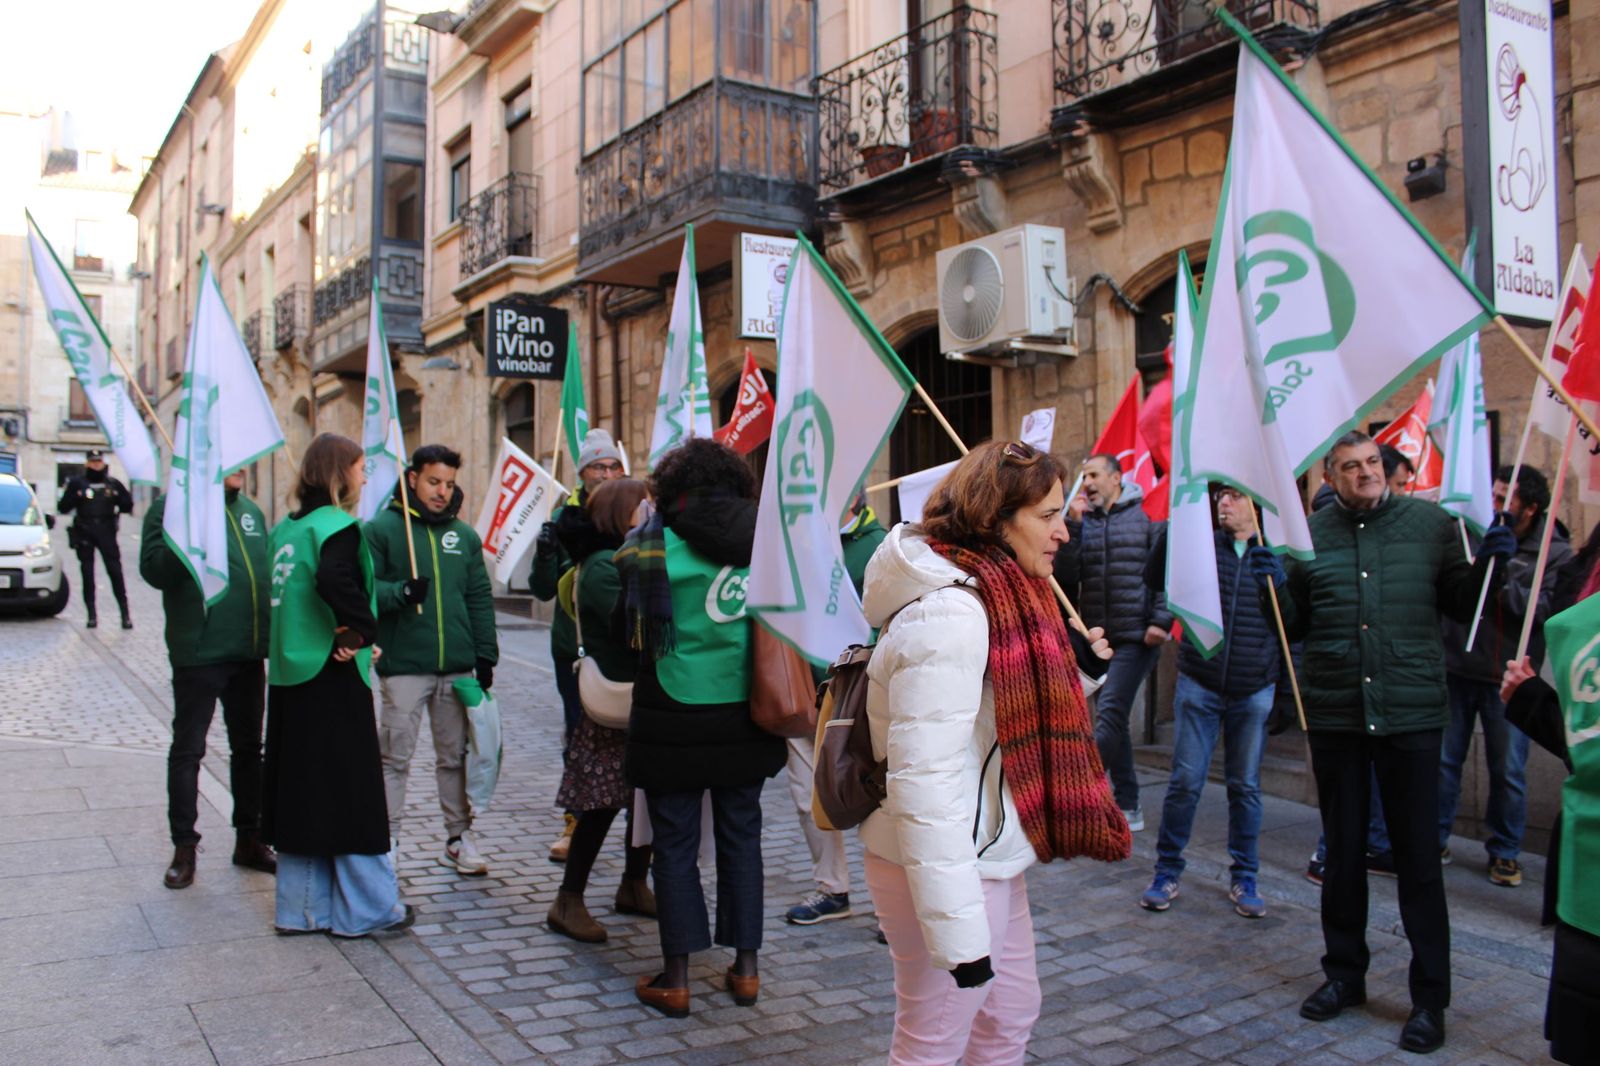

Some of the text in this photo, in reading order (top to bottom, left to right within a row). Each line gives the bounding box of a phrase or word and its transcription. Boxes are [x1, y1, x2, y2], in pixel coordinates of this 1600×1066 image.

[1514, 236, 1534, 265] La
[1496, 263, 1554, 299] Aldaba
[496, 308, 545, 334] iPan
[746, 318, 776, 334] Ald
[496, 332, 555, 358] iVino
[497, 357, 552, 373] vinobar
